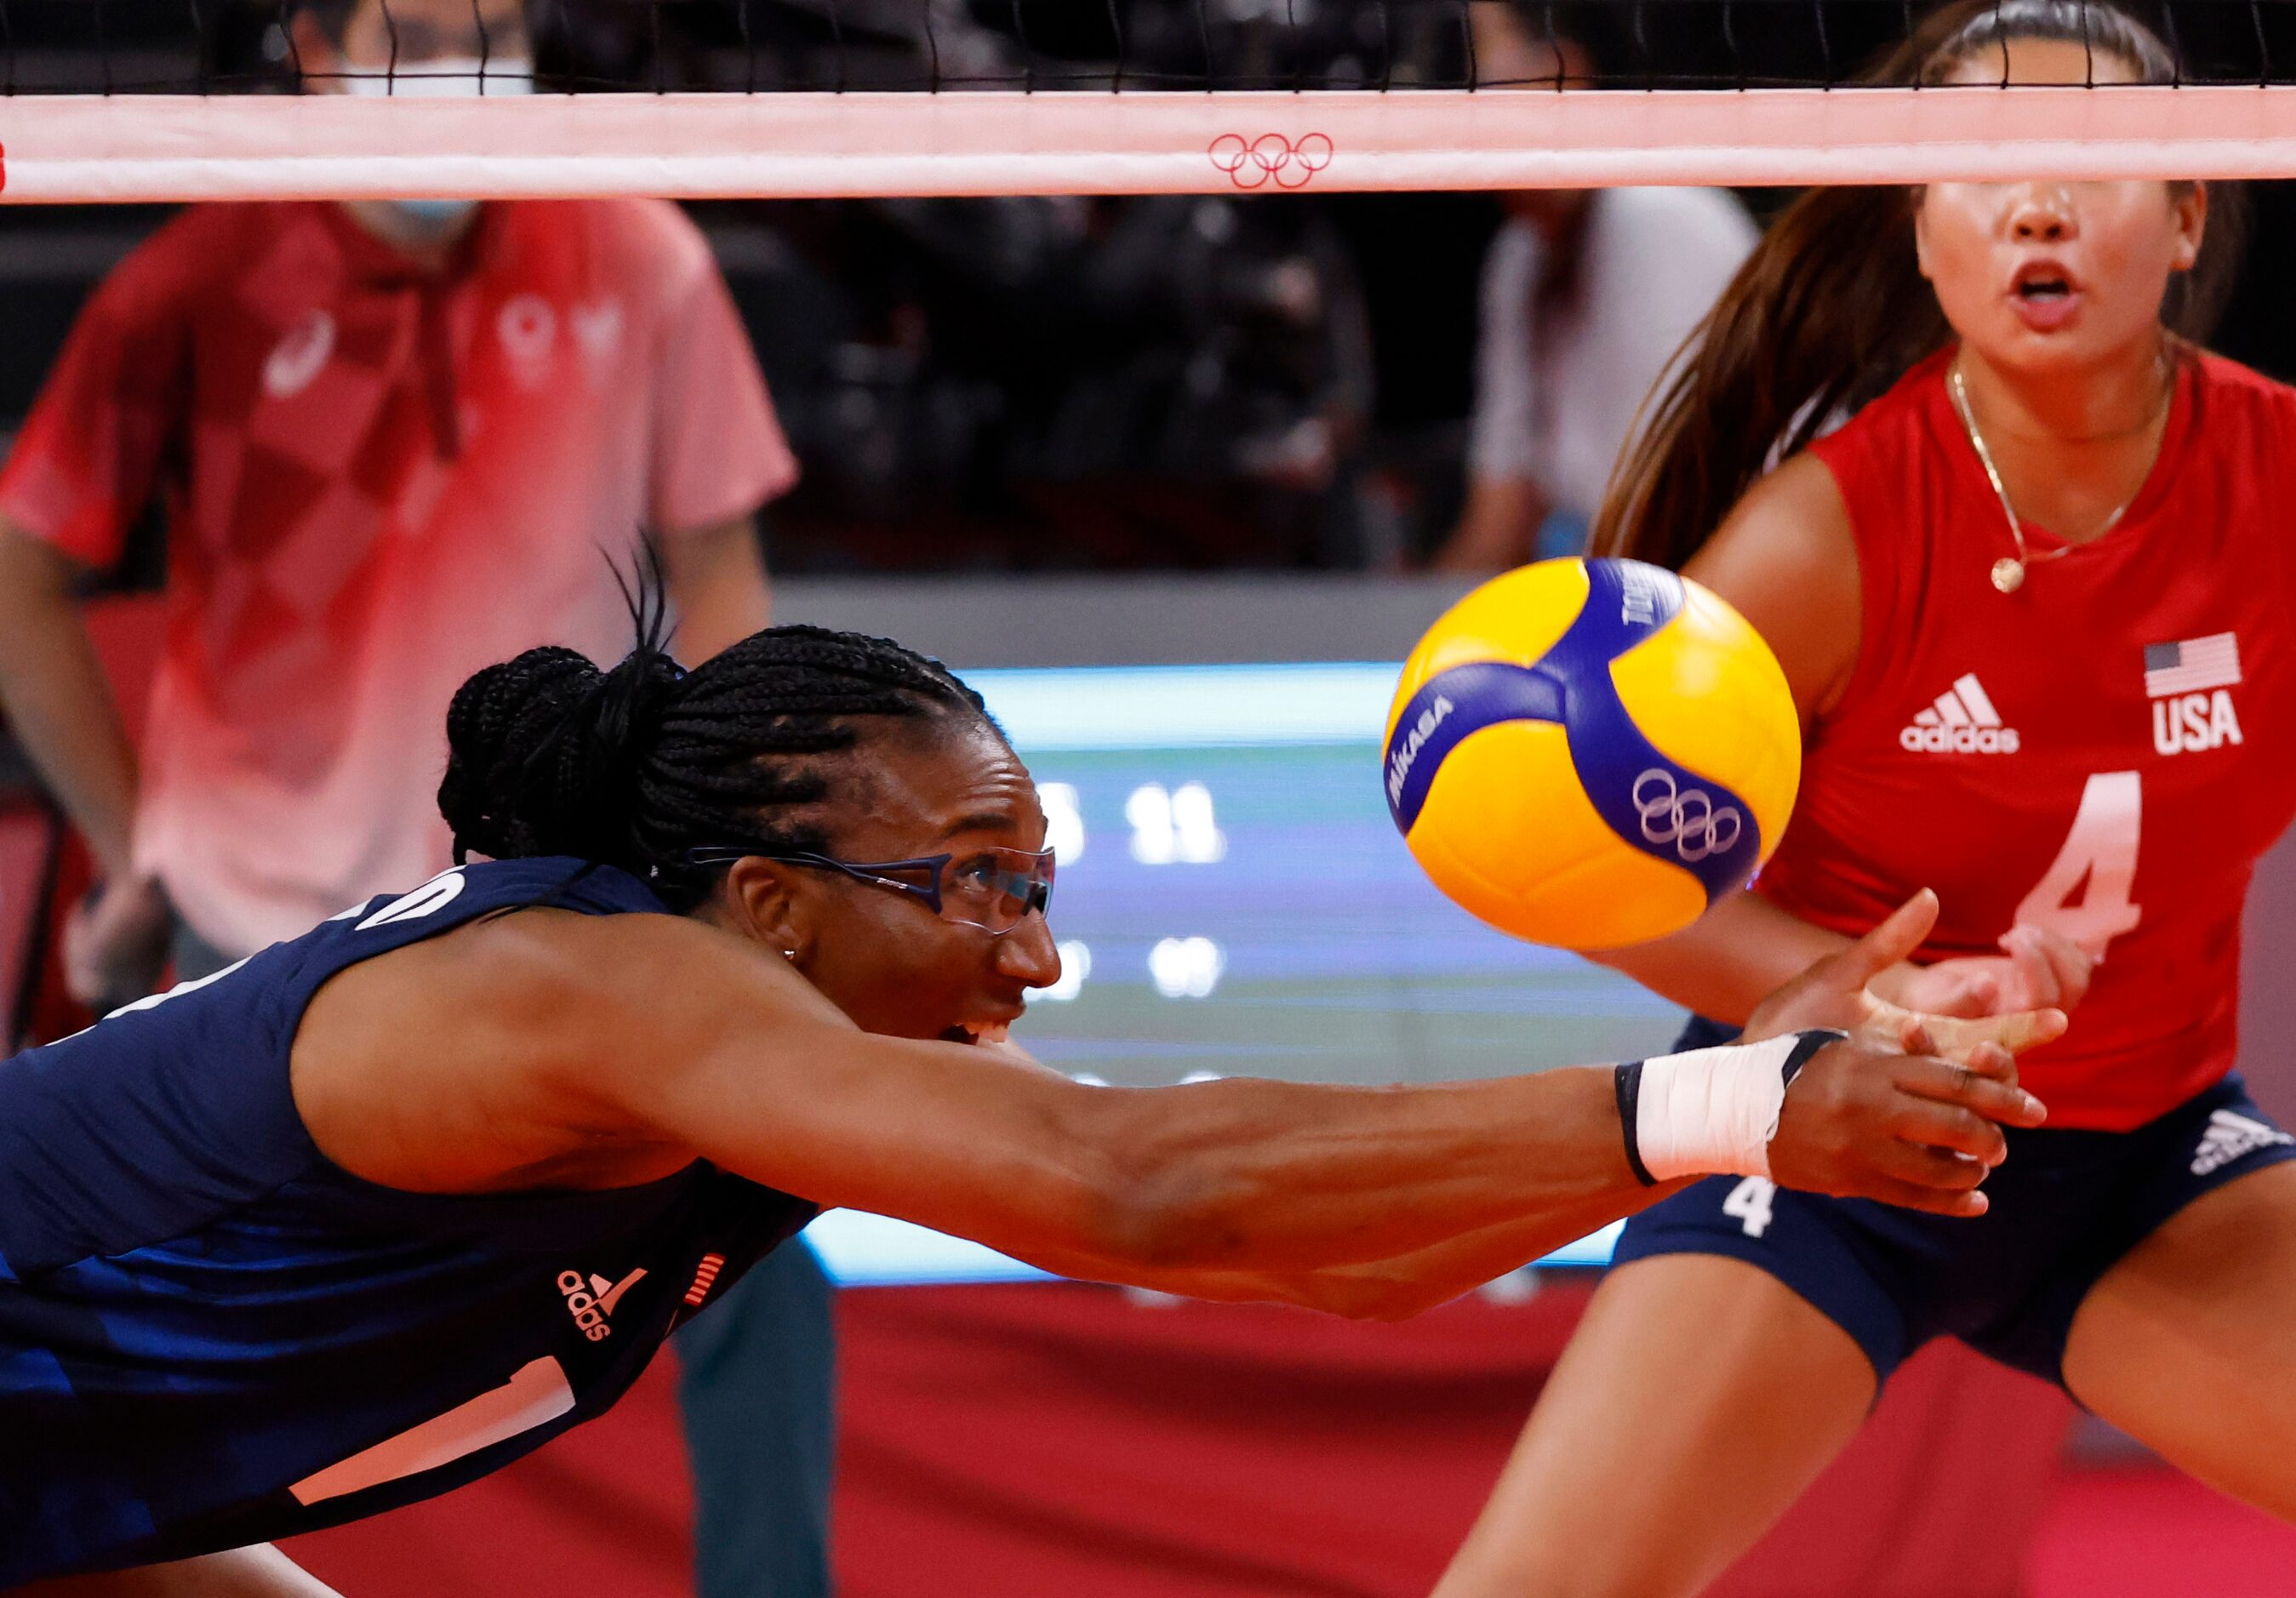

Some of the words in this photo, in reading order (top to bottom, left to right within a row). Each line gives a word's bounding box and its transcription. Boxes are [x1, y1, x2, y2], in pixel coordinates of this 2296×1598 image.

[1899, 722, 2019, 754] adidas
[2152, 690, 2242, 756] USA
[2012, 770, 2142, 965] 4
[1722, 1175, 1777, 1238] 4
